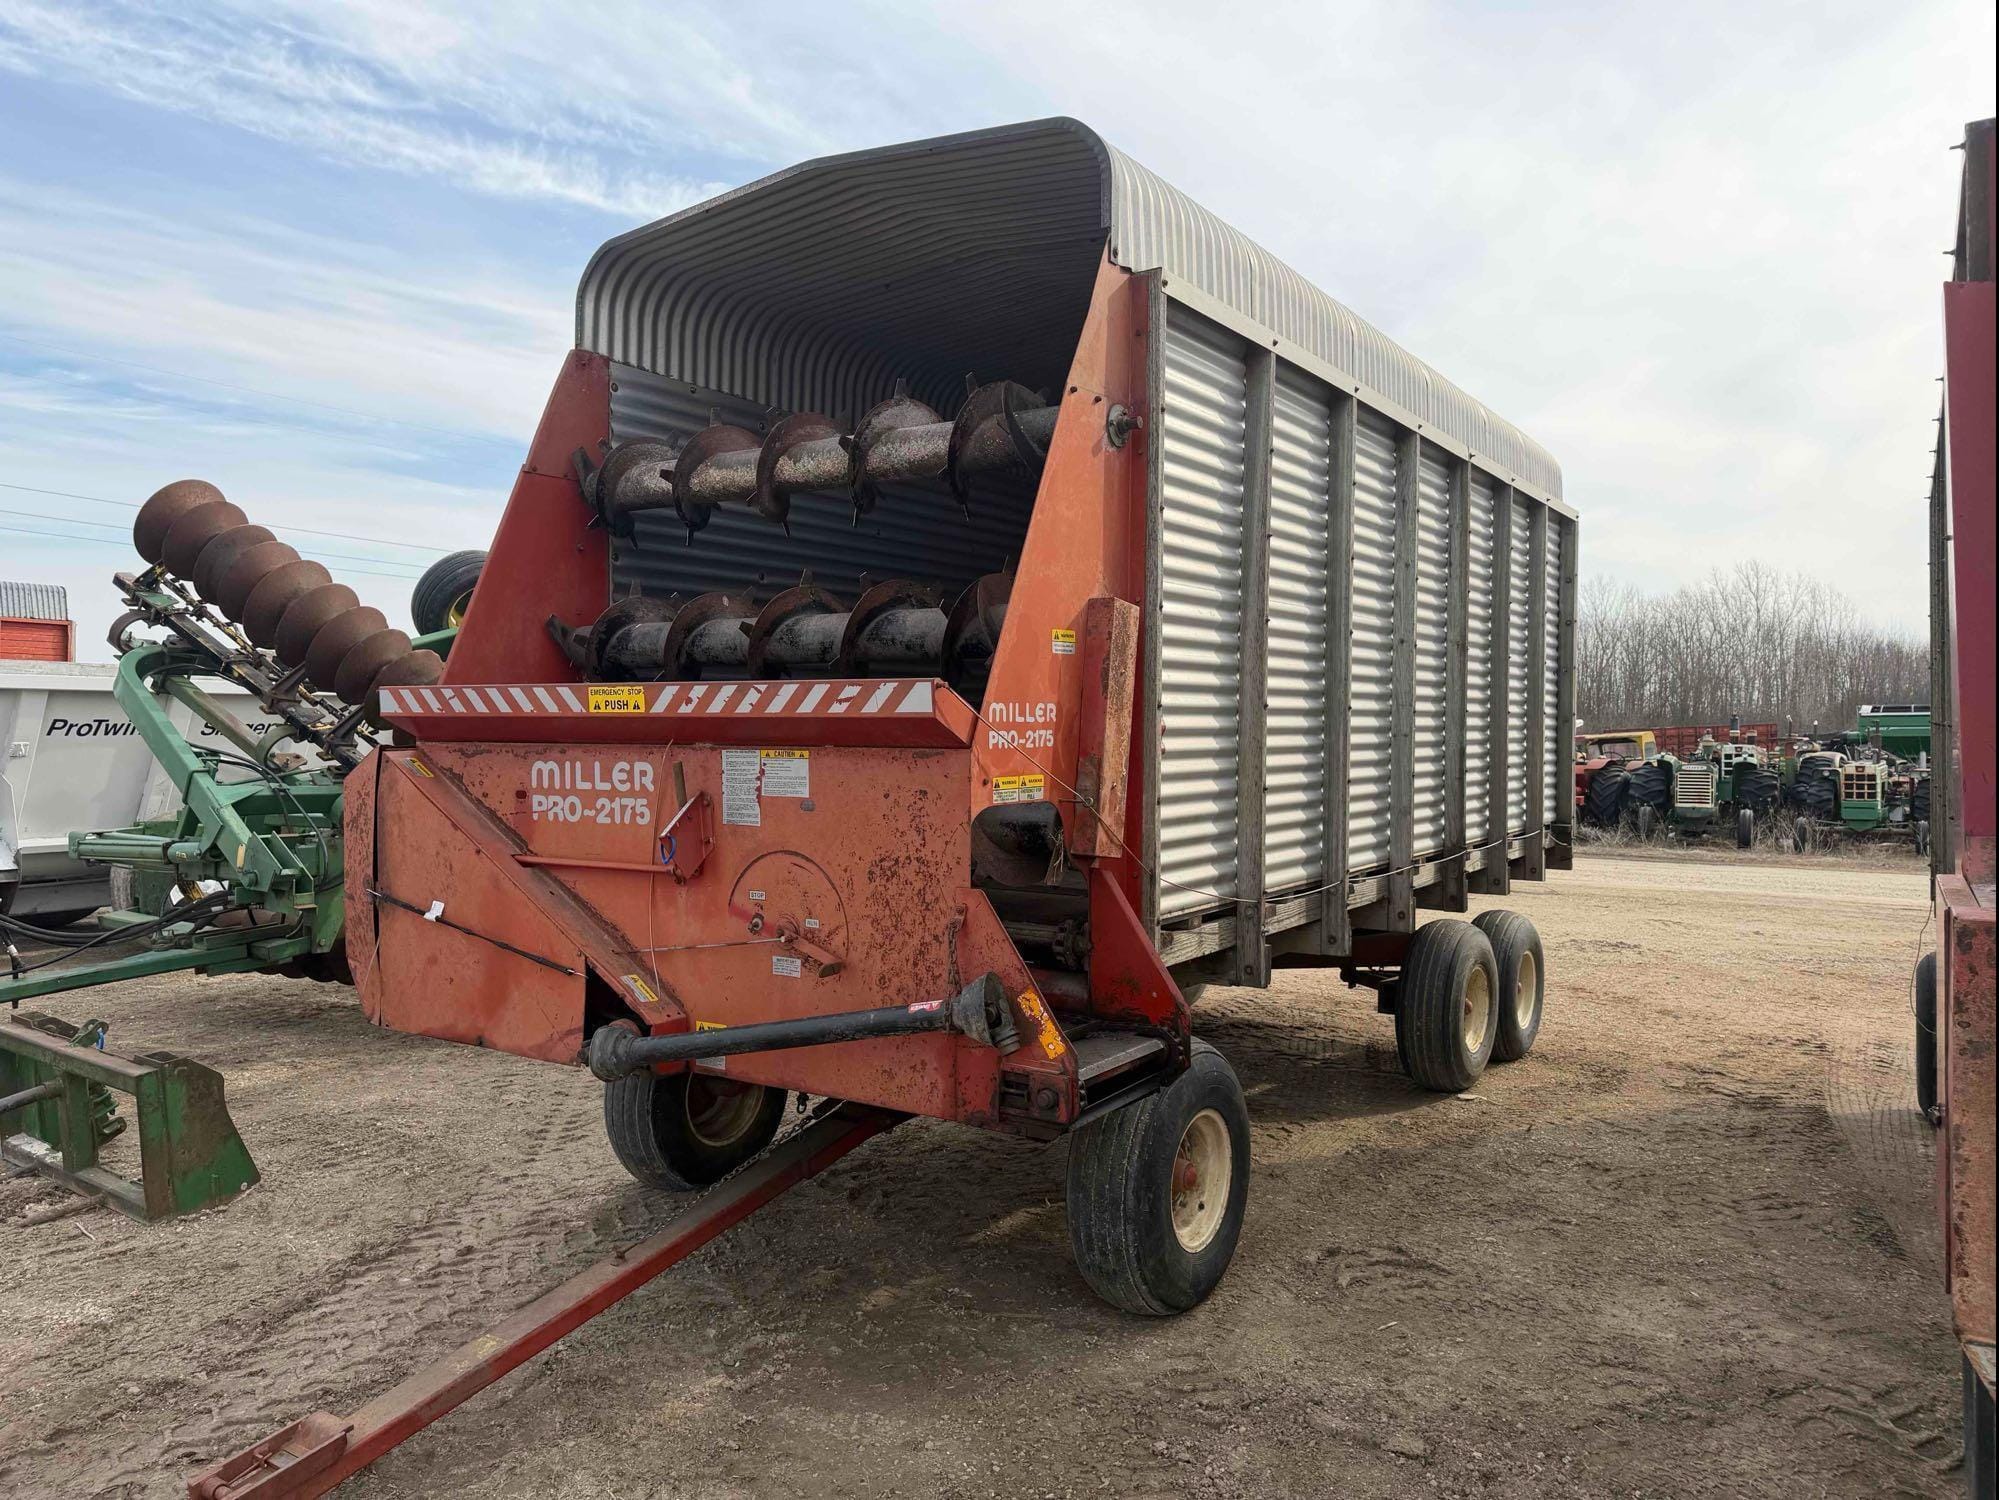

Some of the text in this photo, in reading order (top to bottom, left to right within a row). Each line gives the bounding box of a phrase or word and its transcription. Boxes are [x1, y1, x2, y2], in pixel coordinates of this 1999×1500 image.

[604, 700, 629, 710] PUSH
[989, 702, 1056, 723] MILLER
[989, 730, 1054, 749] PRO-2175
[774, 750, 796, 758] CAUTION
[531, 760, 654, 792] MILLER
